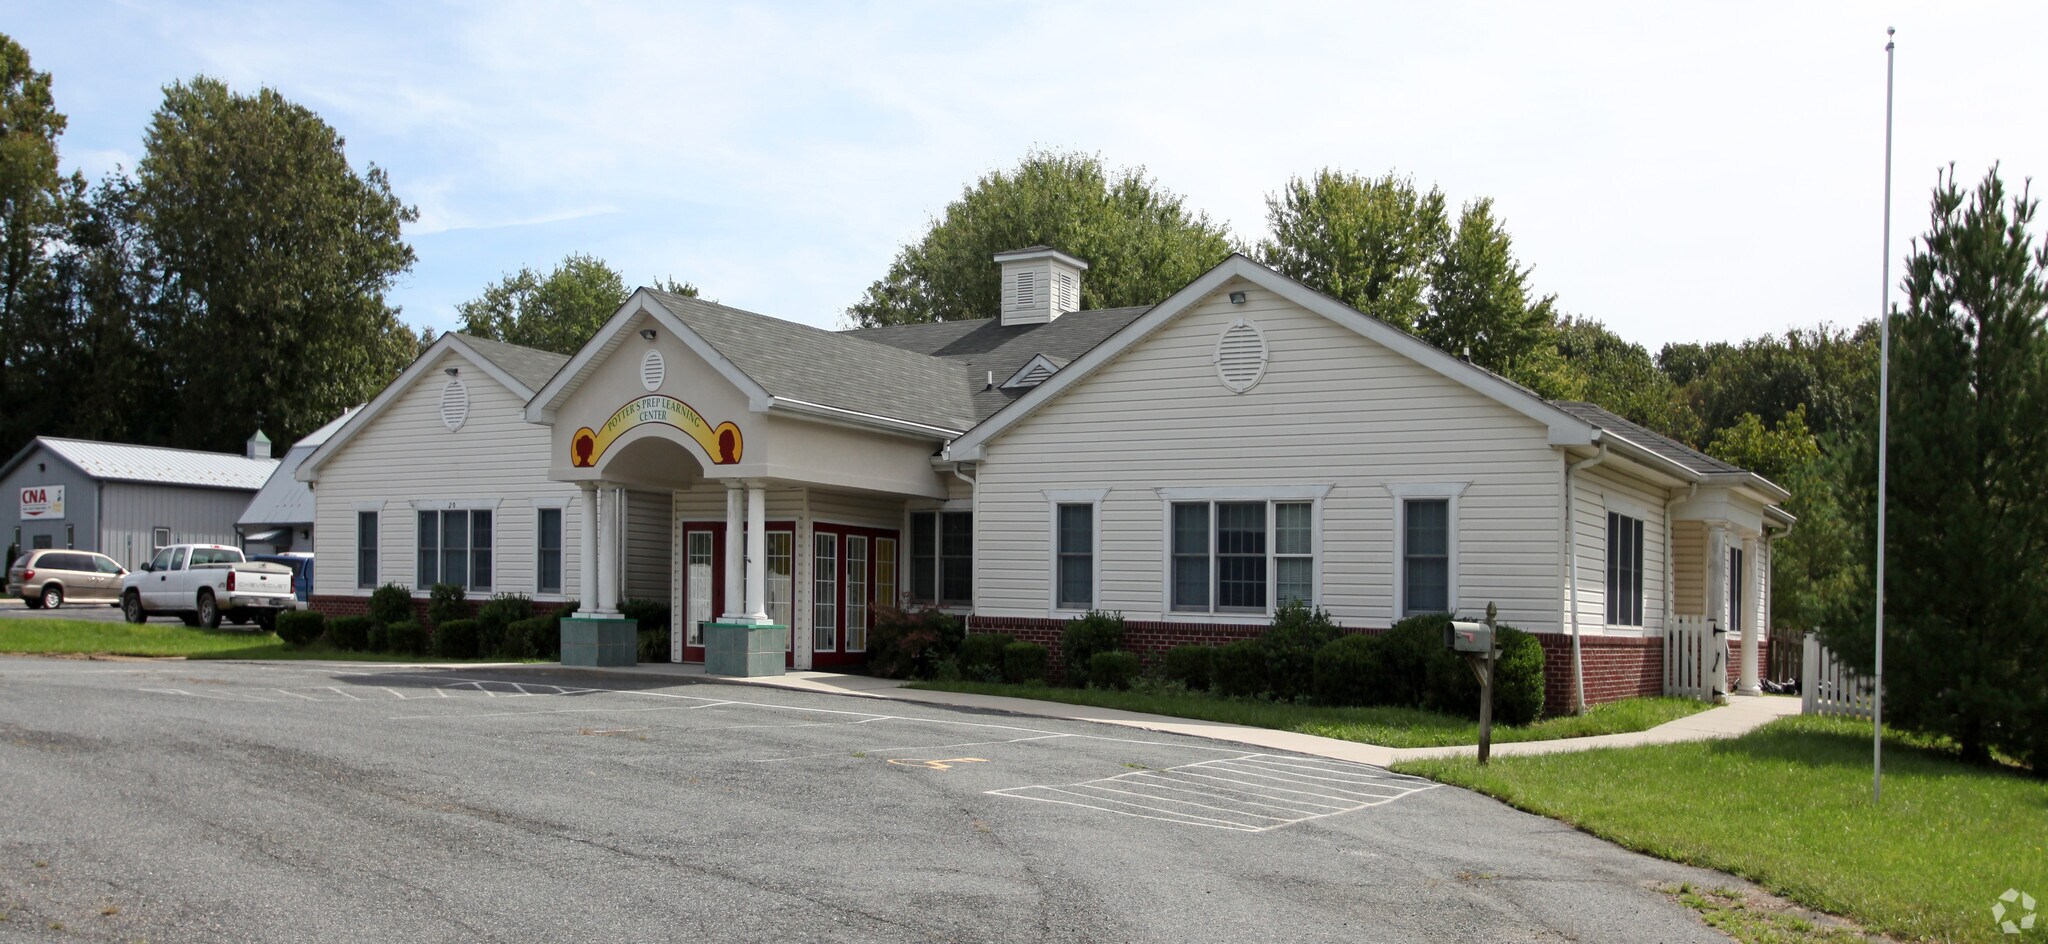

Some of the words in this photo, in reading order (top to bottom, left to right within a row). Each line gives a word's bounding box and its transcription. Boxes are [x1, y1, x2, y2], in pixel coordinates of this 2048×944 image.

[607, 401, 641, 431] POTTER'S
[642, 397, 661, 410] PREP
[661, 398, 701, 428] LEARNING
[639, 410, 667, 422] CENTER
[22, 488, 47, 504] CNA
